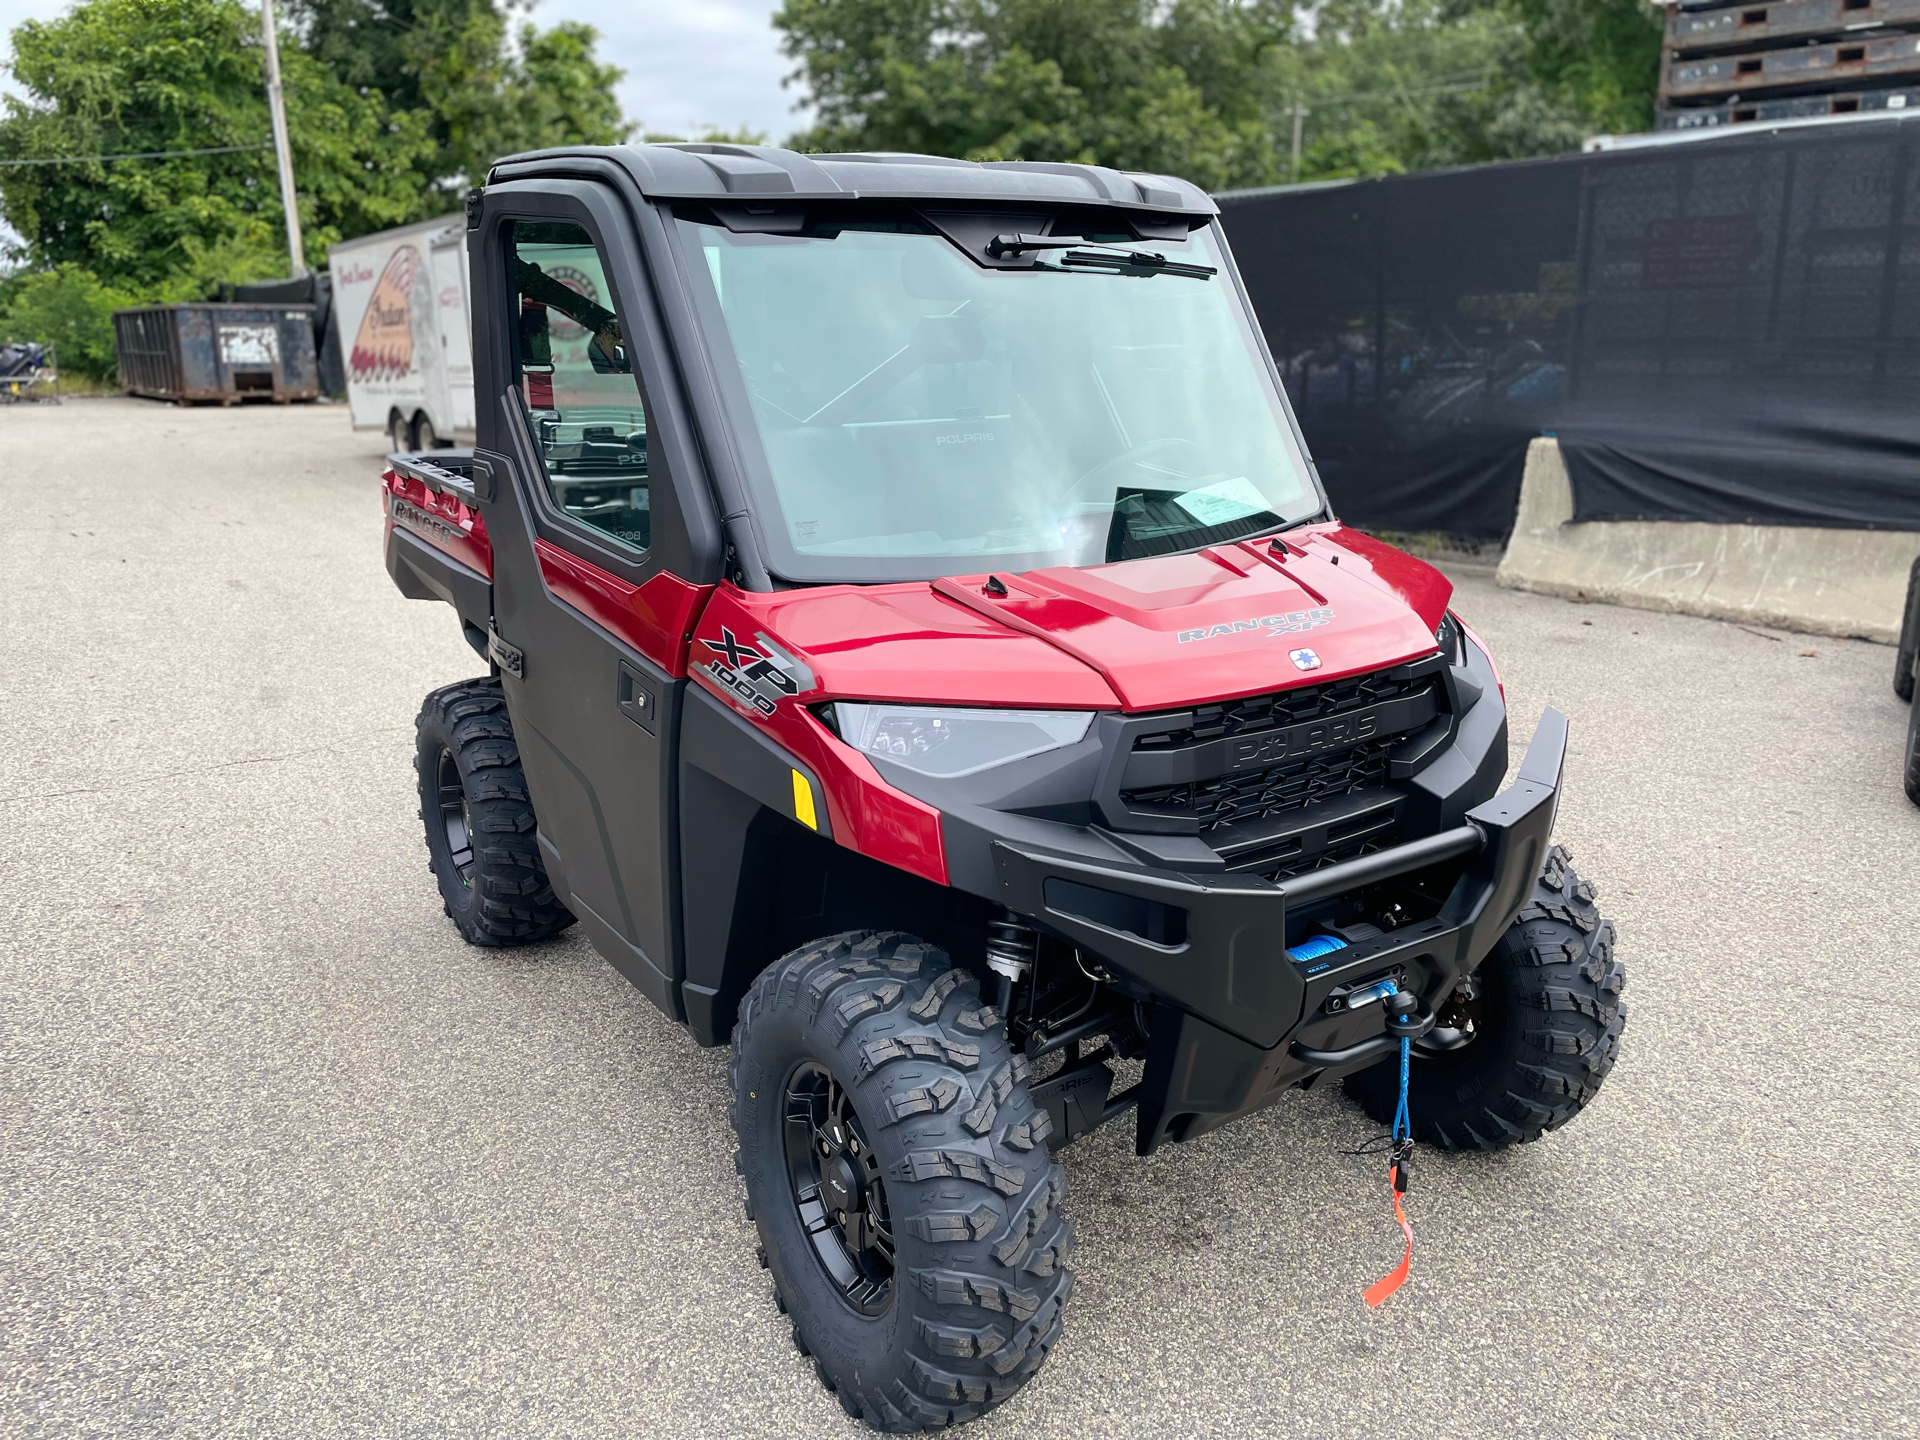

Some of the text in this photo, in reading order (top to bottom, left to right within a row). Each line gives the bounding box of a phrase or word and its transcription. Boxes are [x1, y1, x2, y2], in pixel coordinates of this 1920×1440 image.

[936, 431, 995, 447] POLARIS
[395, 500, 451, 547] RANGER
[1177, 608, 1336, 644] RANGER
[1265, 619, 1331, 638] XP
[698, 625, 800, 696] XP
[707, 673, 769, 721] DUAL OVERHEAD CAM
[710, 660, 778, 716] 1000
[1232, 713, 1378, 768] POLARIS
